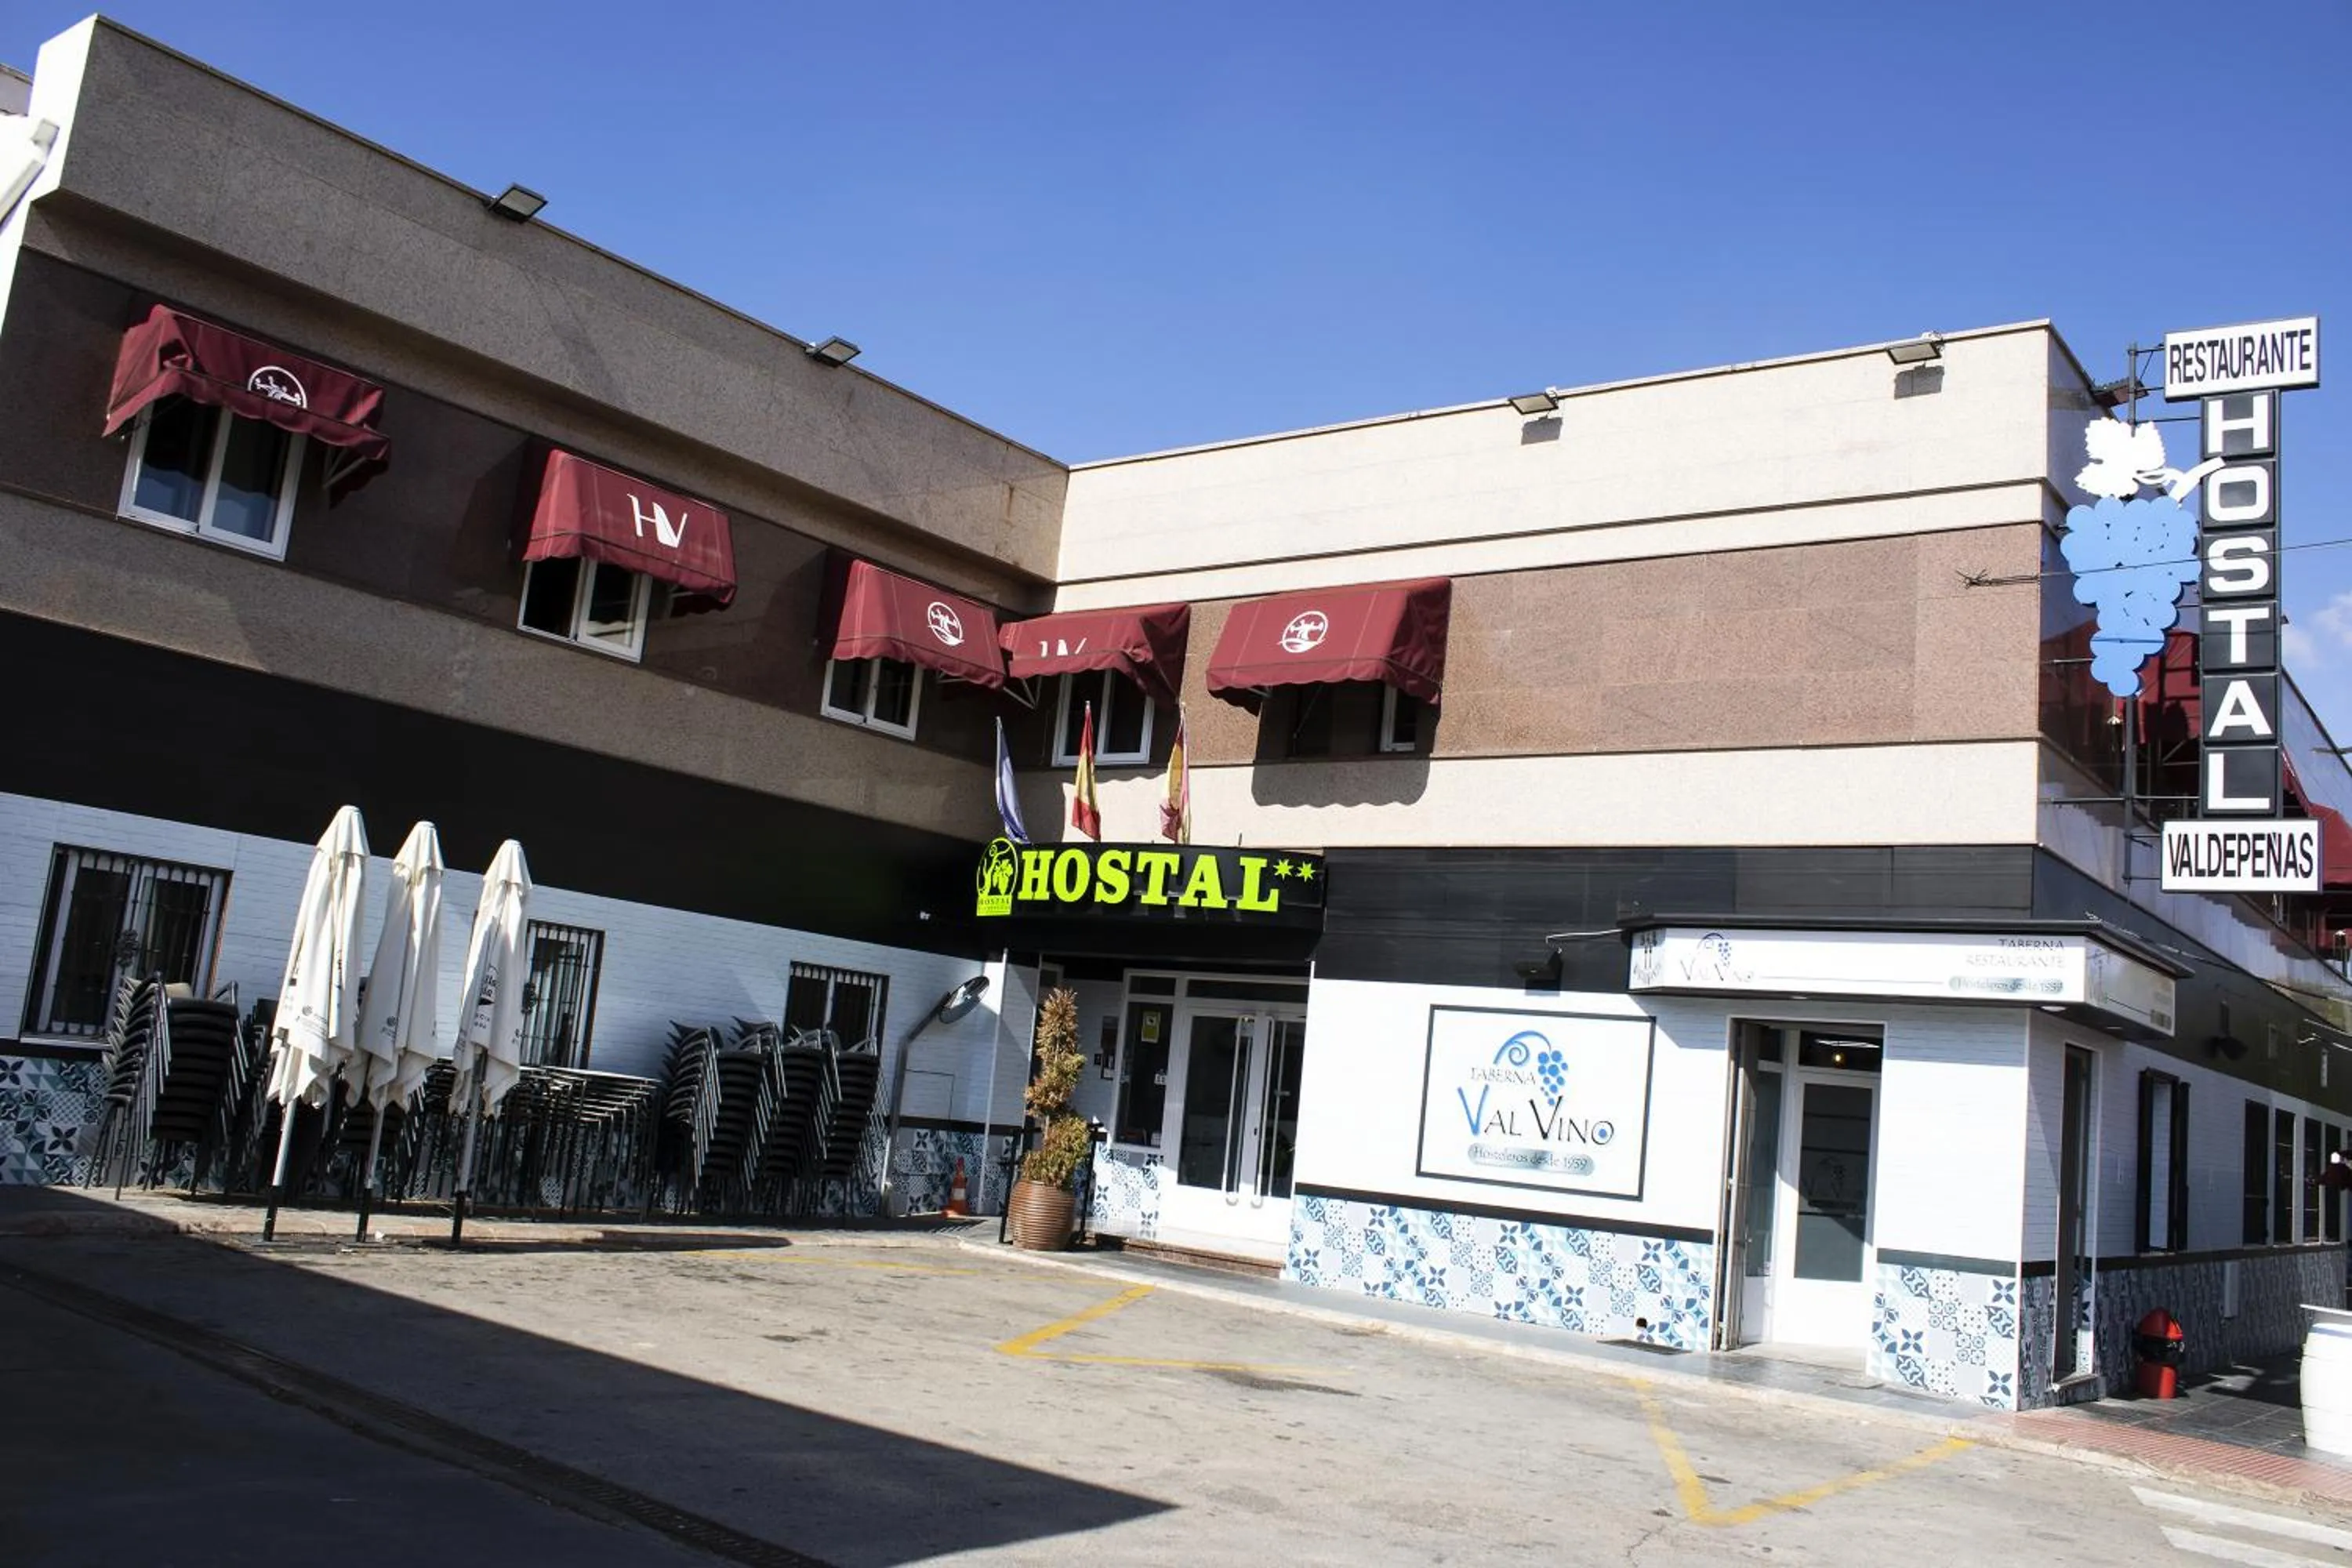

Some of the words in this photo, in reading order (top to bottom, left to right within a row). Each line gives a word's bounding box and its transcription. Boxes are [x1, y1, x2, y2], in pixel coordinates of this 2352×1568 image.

[2169, 328, 2312, 384] RESTAURANTE
[2207, 394, 2273, 810] HOSTAL
[1018, 848, 1279, 913] HOSTAL
[2168, 832, 2314, 879] VALDEPEÑAS
[1470, 1067, 1537, 1085] TABERNA
[1457, 1083, 1522, 1136] VAL
[1530, 1095, 1615, 1145] VINO
[1530, 1150, 1562, 1167] desde
[1563, 1156, 1588, 1171] 1959
